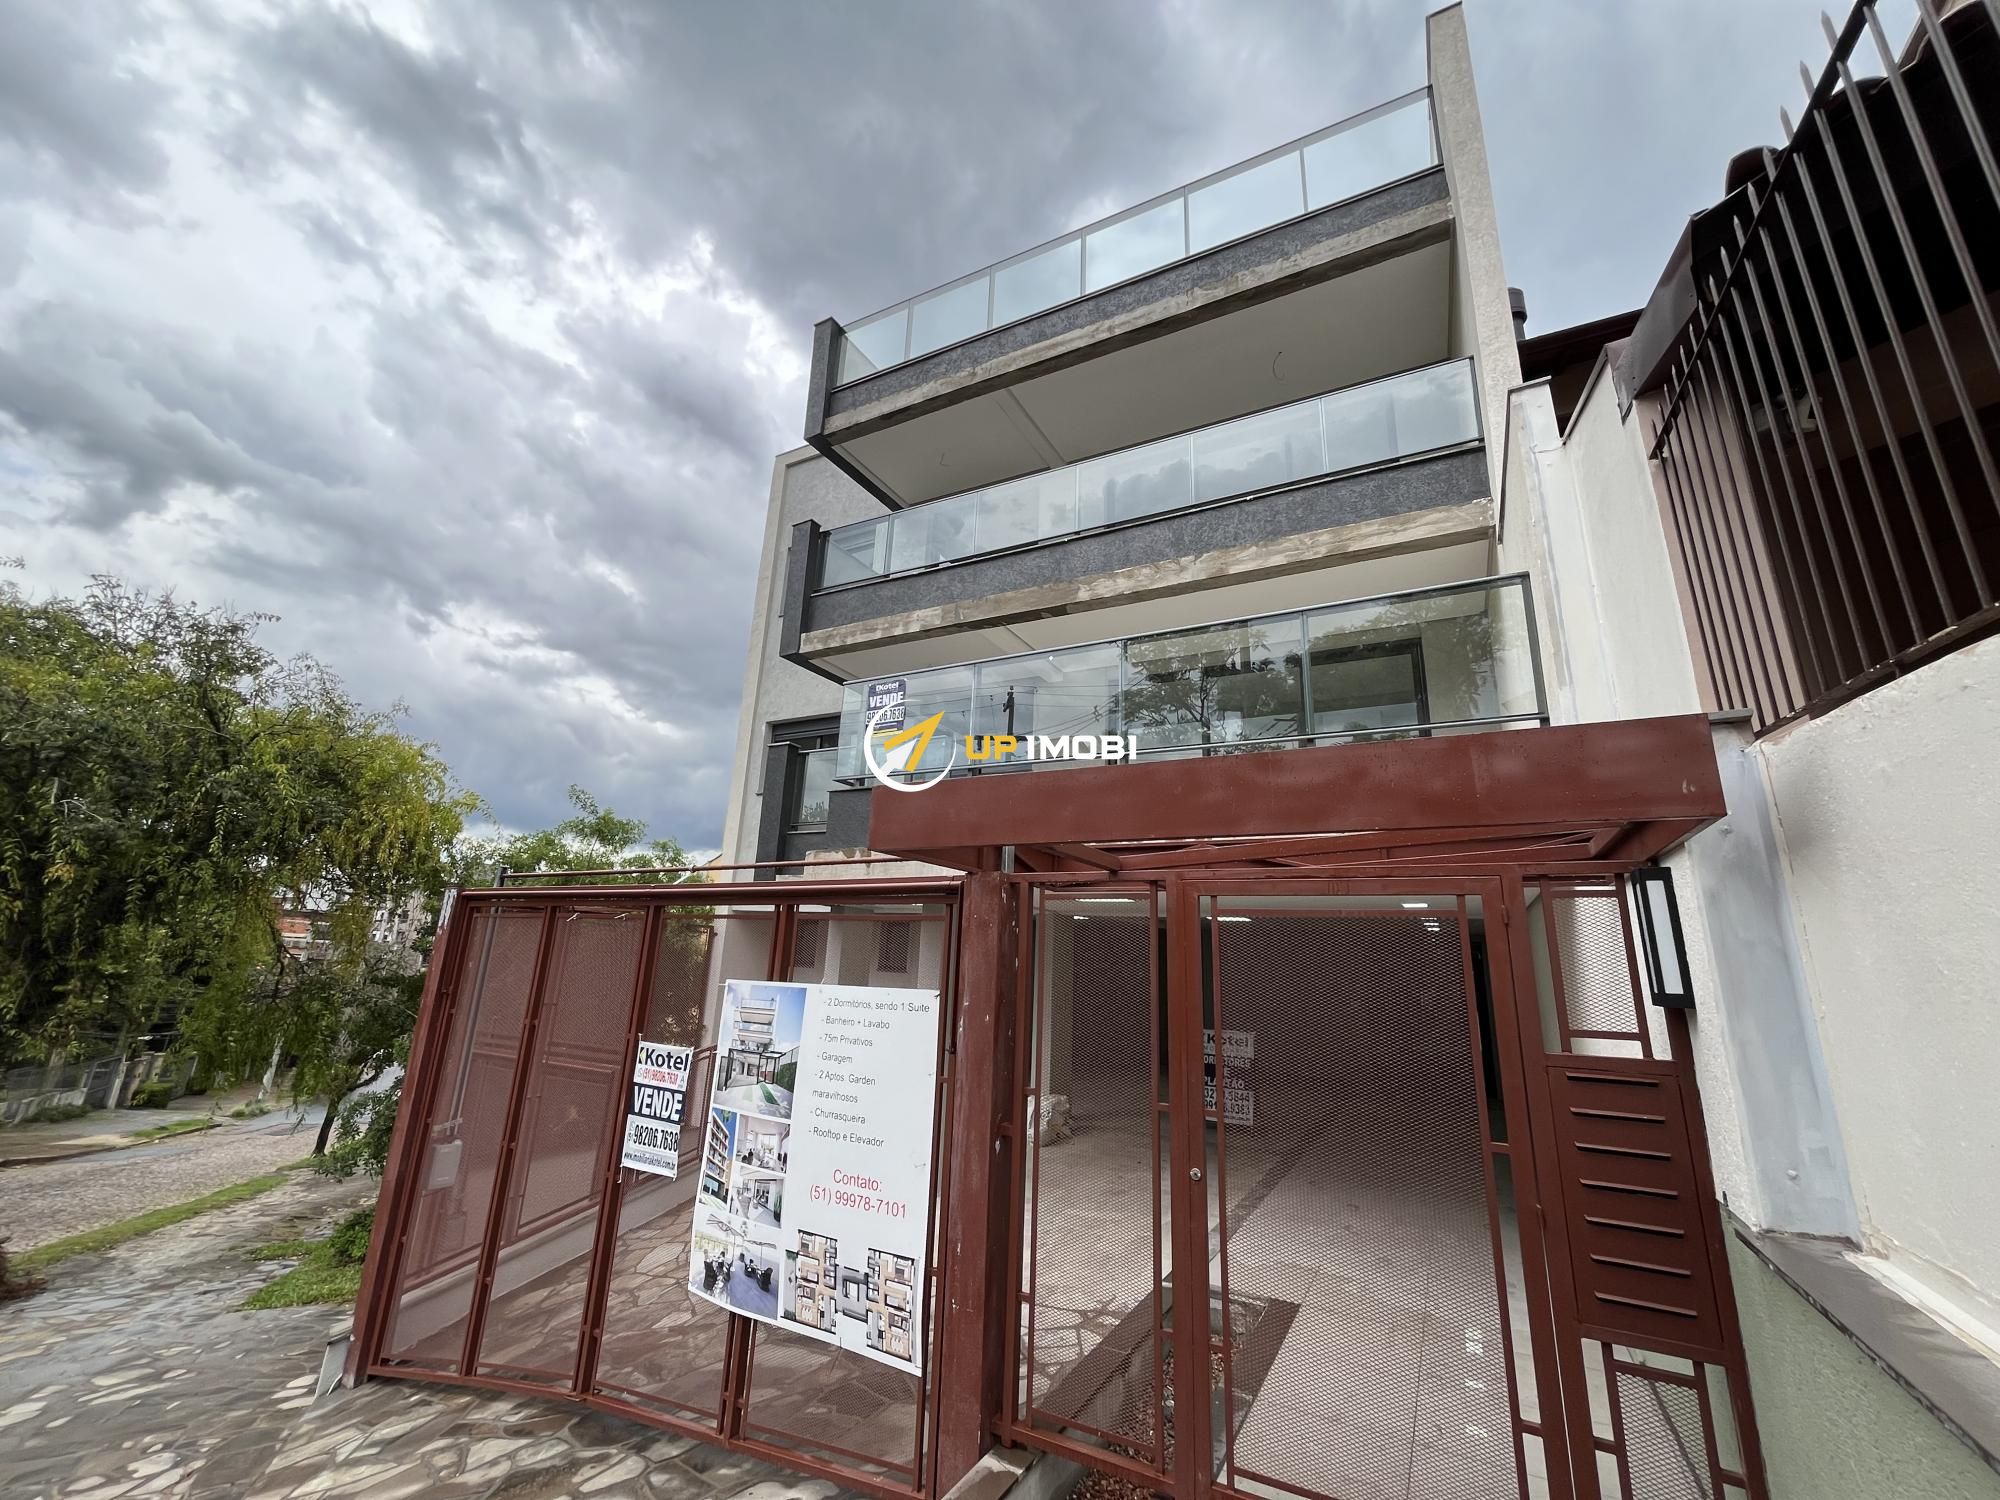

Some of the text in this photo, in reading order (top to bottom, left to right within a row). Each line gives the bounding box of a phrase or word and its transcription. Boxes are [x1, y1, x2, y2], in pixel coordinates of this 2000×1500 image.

[869, 692, 904, 708] VENDE
[828, 998, 833, 1007] 2
[875, 1002, 898, 1011] sendo
[901, 1003, 905, 1011] 1
[908, 1003, 930, 1013] Suite
[826, 1016, 855, 1026] Banheiro
[863, 1018, 890, 1029] Lavabo
[824, 1034, 839, 1043] 75m
[840, 1035, 873, 1047] Privativos
[645, 1048, 690, 1072] Kotel
[822, 1052, 853, 1064] Garagem
[819, 1070, 824, 1079] 2
[824, 1071, 845, 1083] Aptos
[848, 1074, 876, 1086] Garden
[634, 1086, 683, 1122] VENDE
[812, 1089, 858, 1103] maravilhosos
[815, 1107, 866, 1124] Churrasqueira
[633, 1124, 679, 1153] 98206.7638
[813, 1126, 841, 1142] Rooftop
[843, 1133, 848, 1141] e
[850, 1133, 884, 1148] Elevador
[833, 1168, 882, 1192] Contato:
[810, 1184, 907, 1219] (51) 99978-7101
